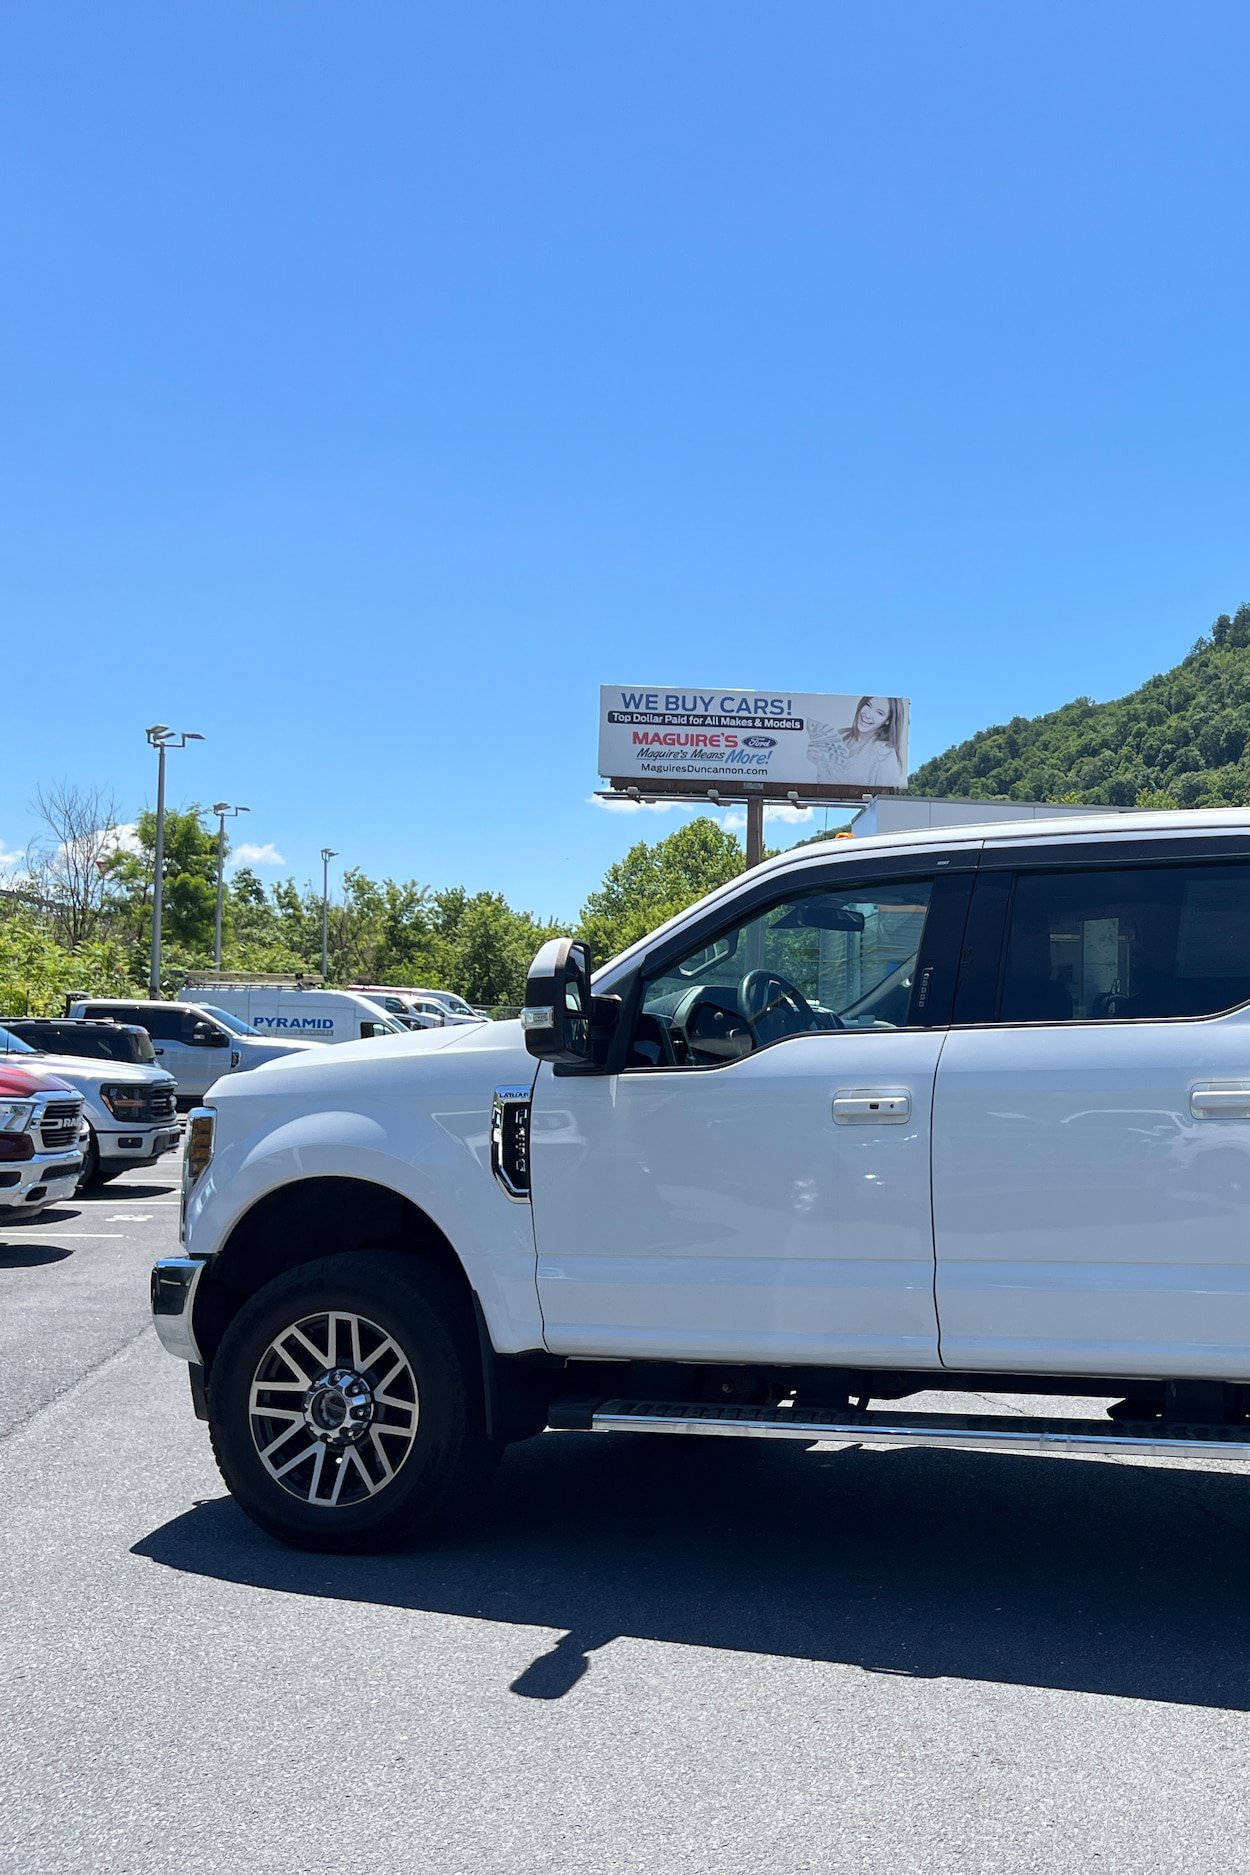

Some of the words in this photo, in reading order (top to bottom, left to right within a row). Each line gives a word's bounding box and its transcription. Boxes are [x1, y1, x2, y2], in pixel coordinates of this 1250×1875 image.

[621, 692, 658, 710] WE
[665, 694, 715, 712] BUY
[720, 696, 792, 716] CARS!
[612, 712, 631, 723] Top
[632, 713, 663, 724] Dollar
[665, 714, 687, 724] Paid
[689, 715, 703, 725] for
[705, 716, 719, 726] All
[720, 716, 753, 727] Makes
[754, 718, 762, 727] &
[764, 718, 801, 729] Models
[632, 731, 738, 748] MAGUIRE'S
[748, 736, 771, 747] Ford
[636, 747, 688, 761] Maguire's
[690, 748, 725, 760] Means
[724, 749, 773, 765] More!
[641, 763, 768, 776] MaguiresDuncannon.com
[253, 1016, 334, 1029] PYRAMID
